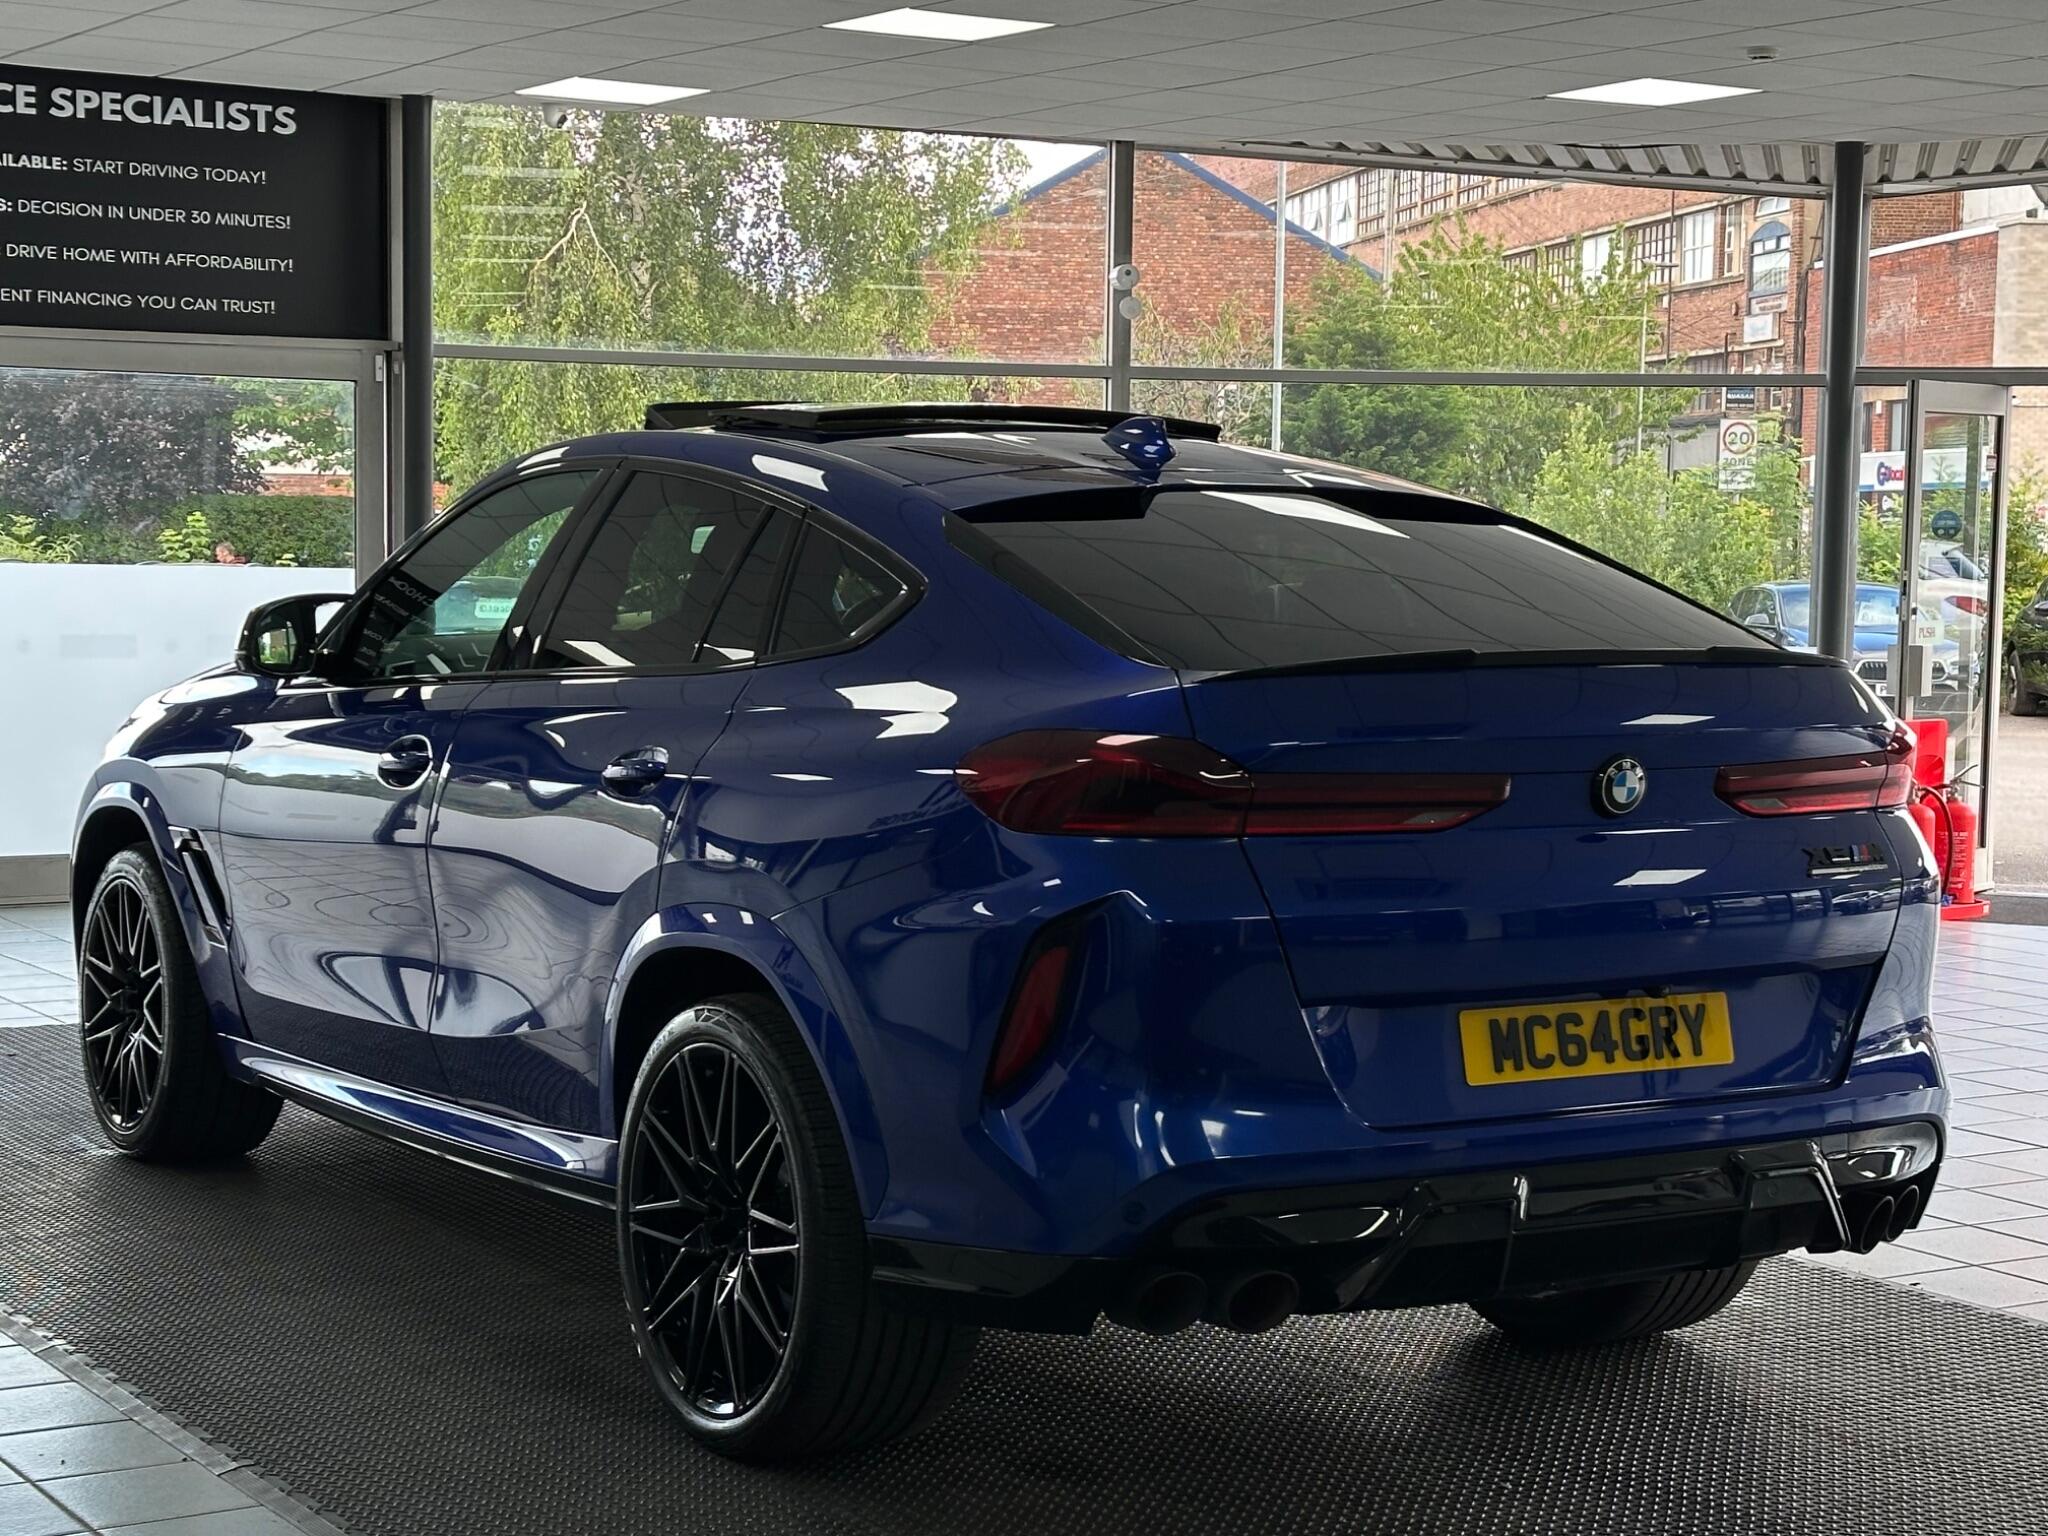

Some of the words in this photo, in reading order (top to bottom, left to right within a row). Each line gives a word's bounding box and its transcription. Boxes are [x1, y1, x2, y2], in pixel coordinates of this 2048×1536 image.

[48, 87, 297, 135] SPECIALISTS
[0, 153, 68, 171] ILABLE:
[73, 158, 124, 174] START
[129, 162, 199, 179] DRIVING
[203, 167, 266, 184] TODAY!
[17, 199, 103, 218] DECISION
[108, 205, 124, 219] IN
[129, 205, 186, 223] UNDER
[191, 210, 211, 224] 30
[215, 212, 291, 229] MINUTES!
[6, 243, 57, 260] DRIVE
[63, 246, 116, 263] HOME
[120, 249, 160, 265] WITH
[164, 252, 293, 272] AFFORDABILITY!
[0, 287, 32, 302] ENT
[37, 289, 132, 307] FINANCING
[137, 294, 176, 309] YOU
[180, 297, 217, 312] CAN
[221, 298, 276, 314] TRUST!
[1728, 430, 1750, 445] 20
[1488, 1002, 1706, 1075] MC64GRY
